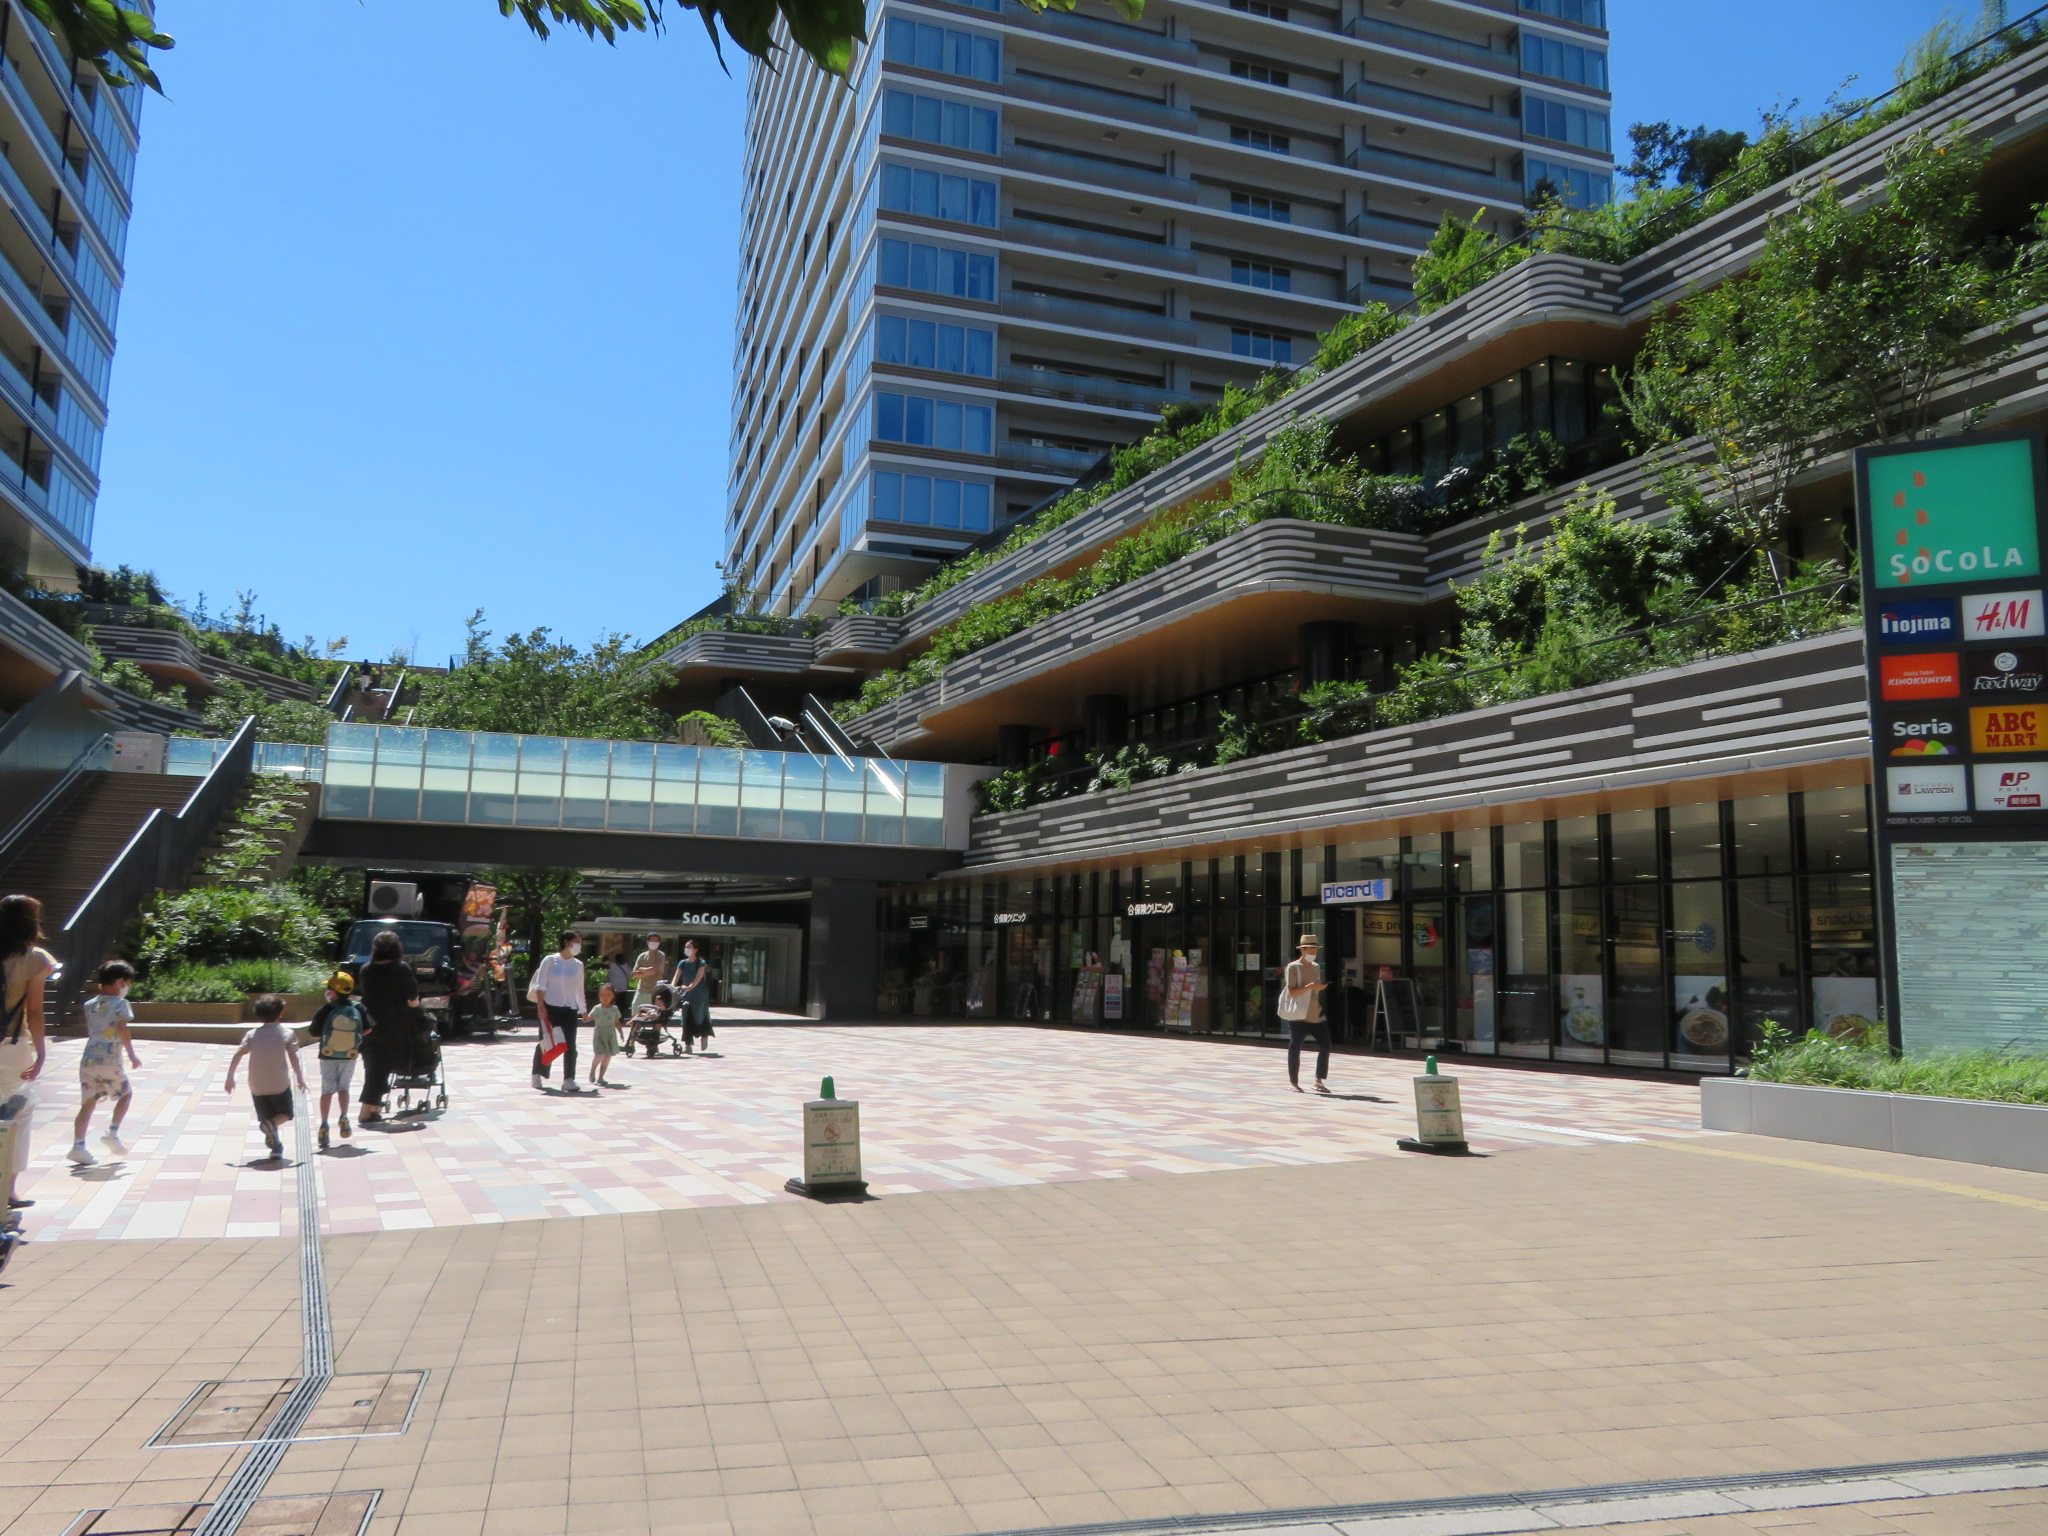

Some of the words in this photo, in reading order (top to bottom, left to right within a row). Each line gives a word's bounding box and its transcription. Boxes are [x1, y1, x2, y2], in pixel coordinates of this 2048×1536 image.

[1975, 599, 2030, 632] H&M
[1888, 676, 1953, 686] KINOKUNIYA
[1893, 719, 1953, 737] Seria
[1986, 711, 2037, 733] ABC
[1986, 732, 2037, 747] MART
[2000, 771, 2030, 787] JP
[1323, 881, 1371, 902] picard
